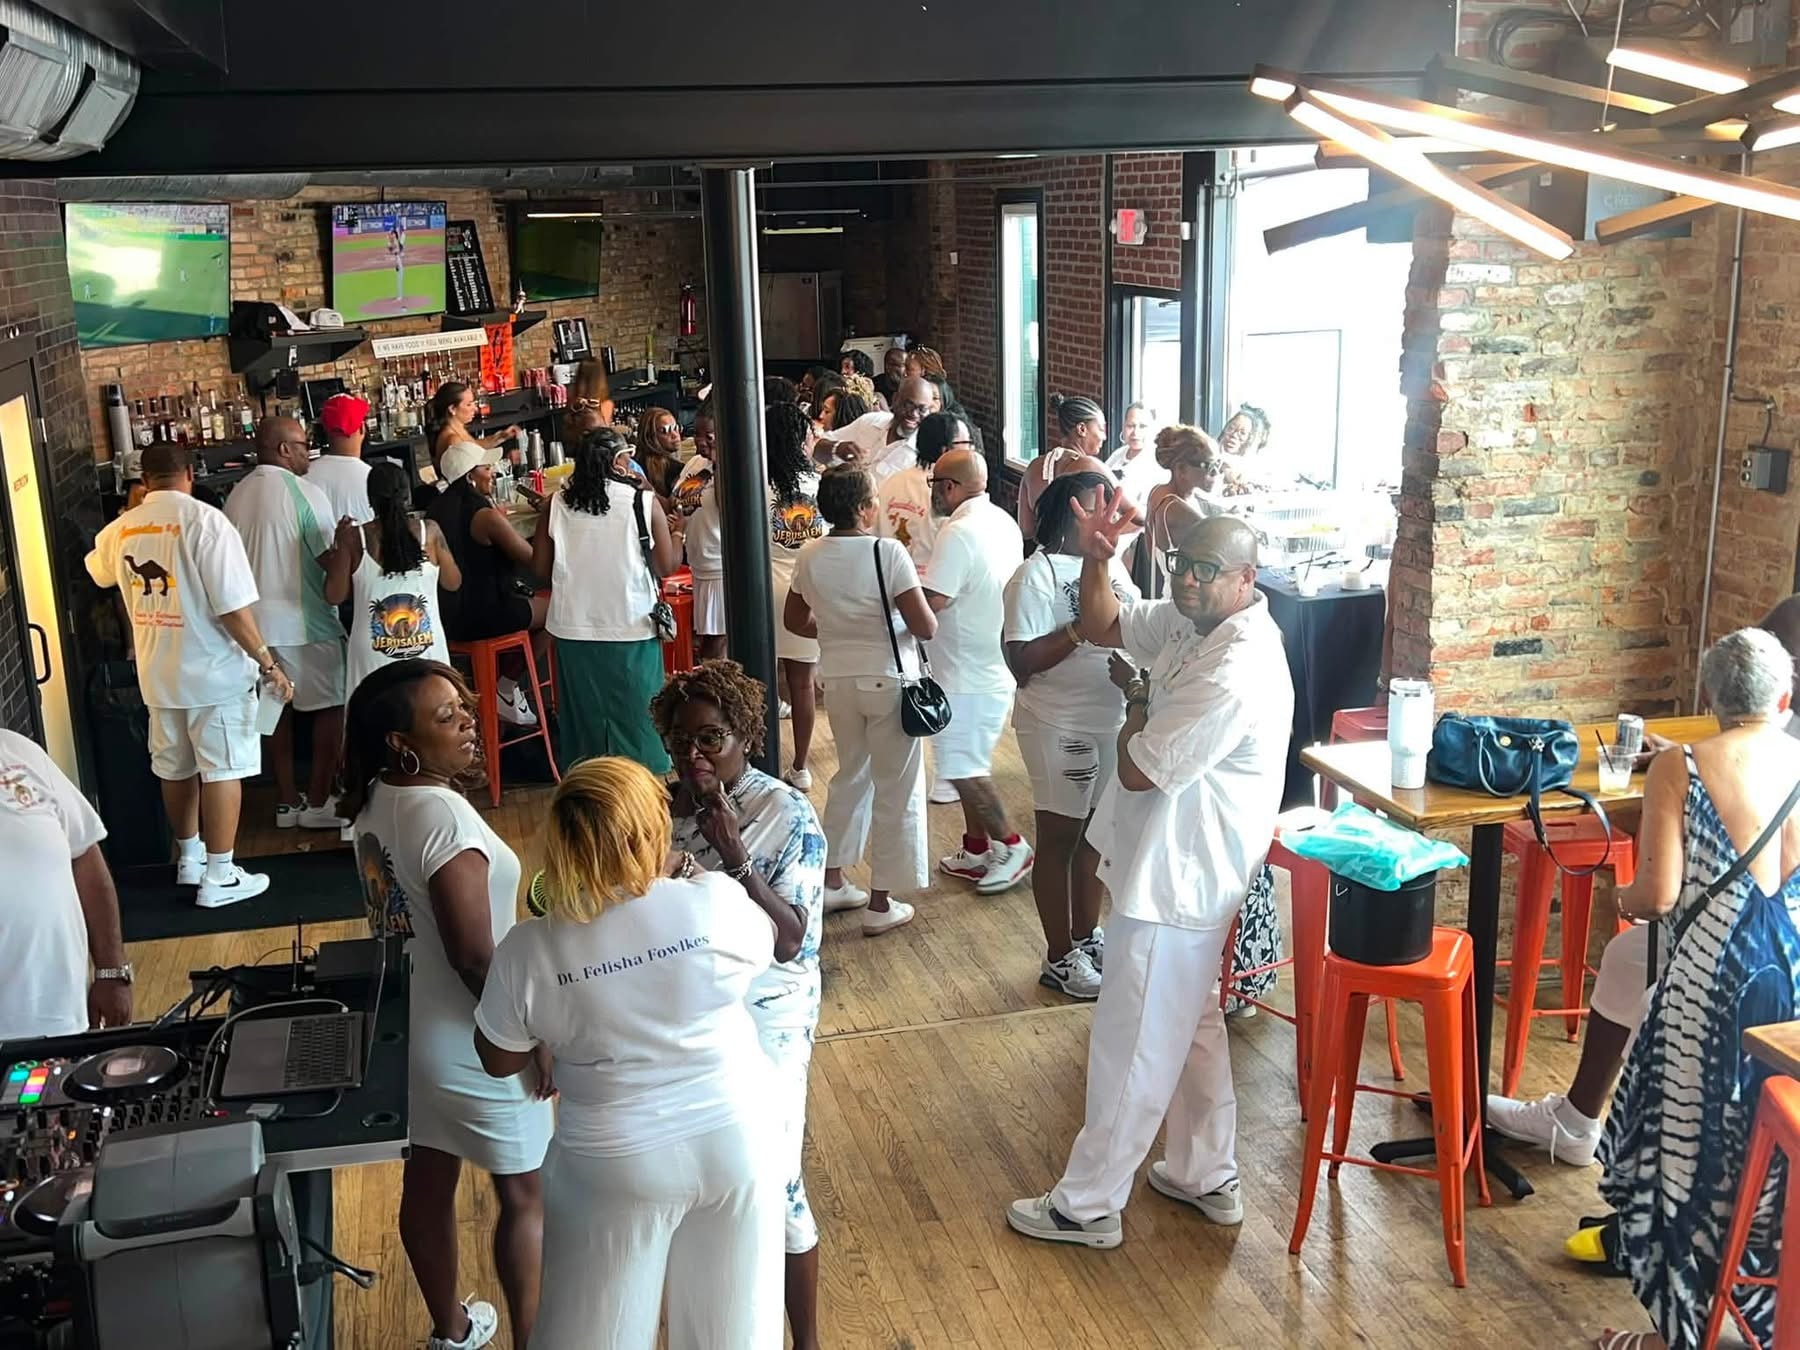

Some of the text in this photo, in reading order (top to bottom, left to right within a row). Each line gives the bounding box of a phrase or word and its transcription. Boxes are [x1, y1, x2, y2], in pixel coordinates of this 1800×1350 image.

[373, 630, 434, 649] JERUSALEM
[583, 954, 644, 980] Felisha
[647, 934, 710, 962] Fowlkes
